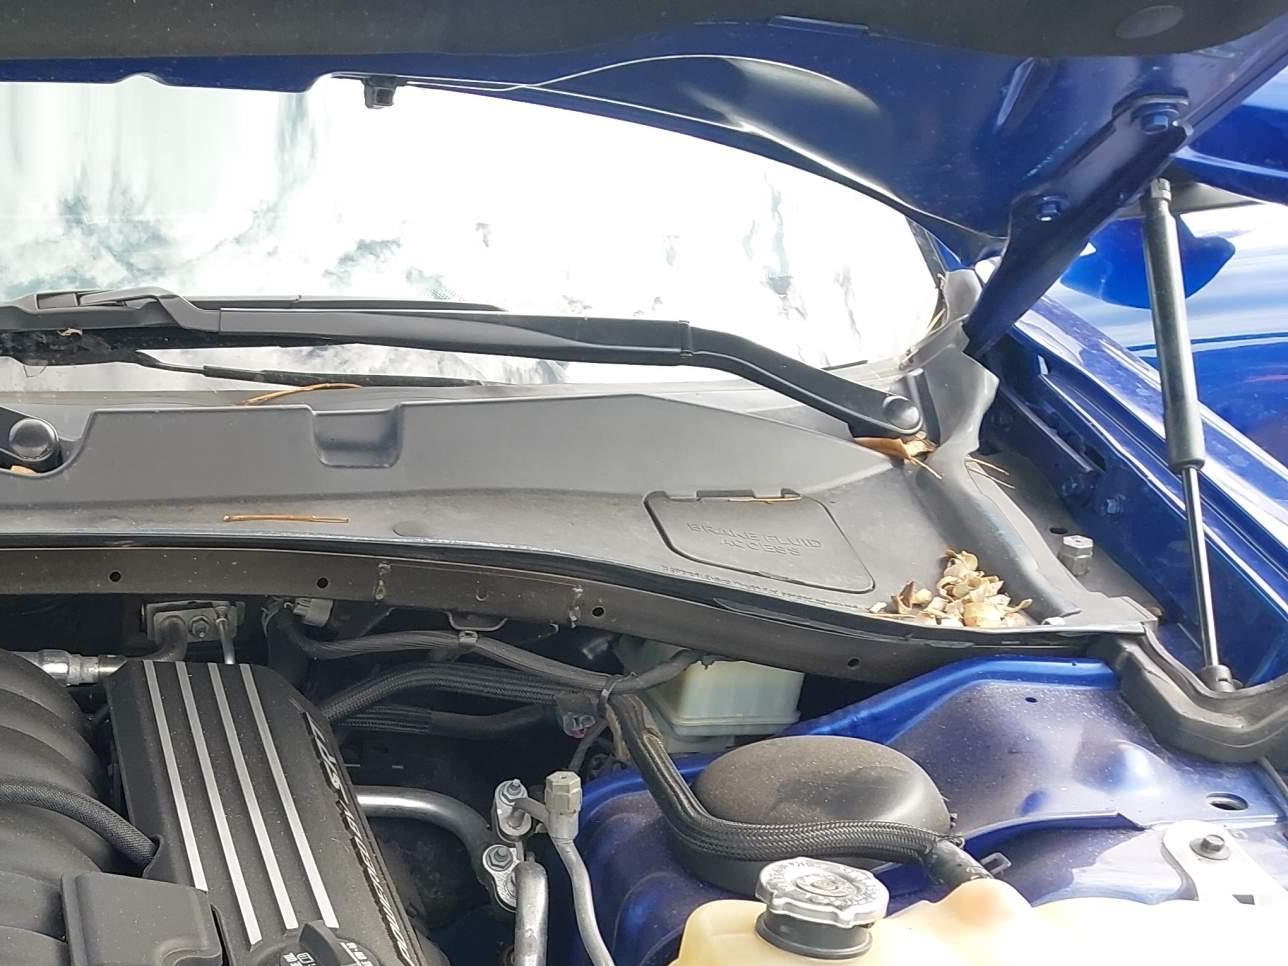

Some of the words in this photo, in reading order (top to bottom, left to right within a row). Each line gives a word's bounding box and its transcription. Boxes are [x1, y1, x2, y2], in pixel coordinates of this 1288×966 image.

[687, 521, 760, 542] BRAKE
[762, 534, 823, 549] FLUID
[721, 538, 801, 556] ACCESS
[305, 710, 349, 805] SRT
